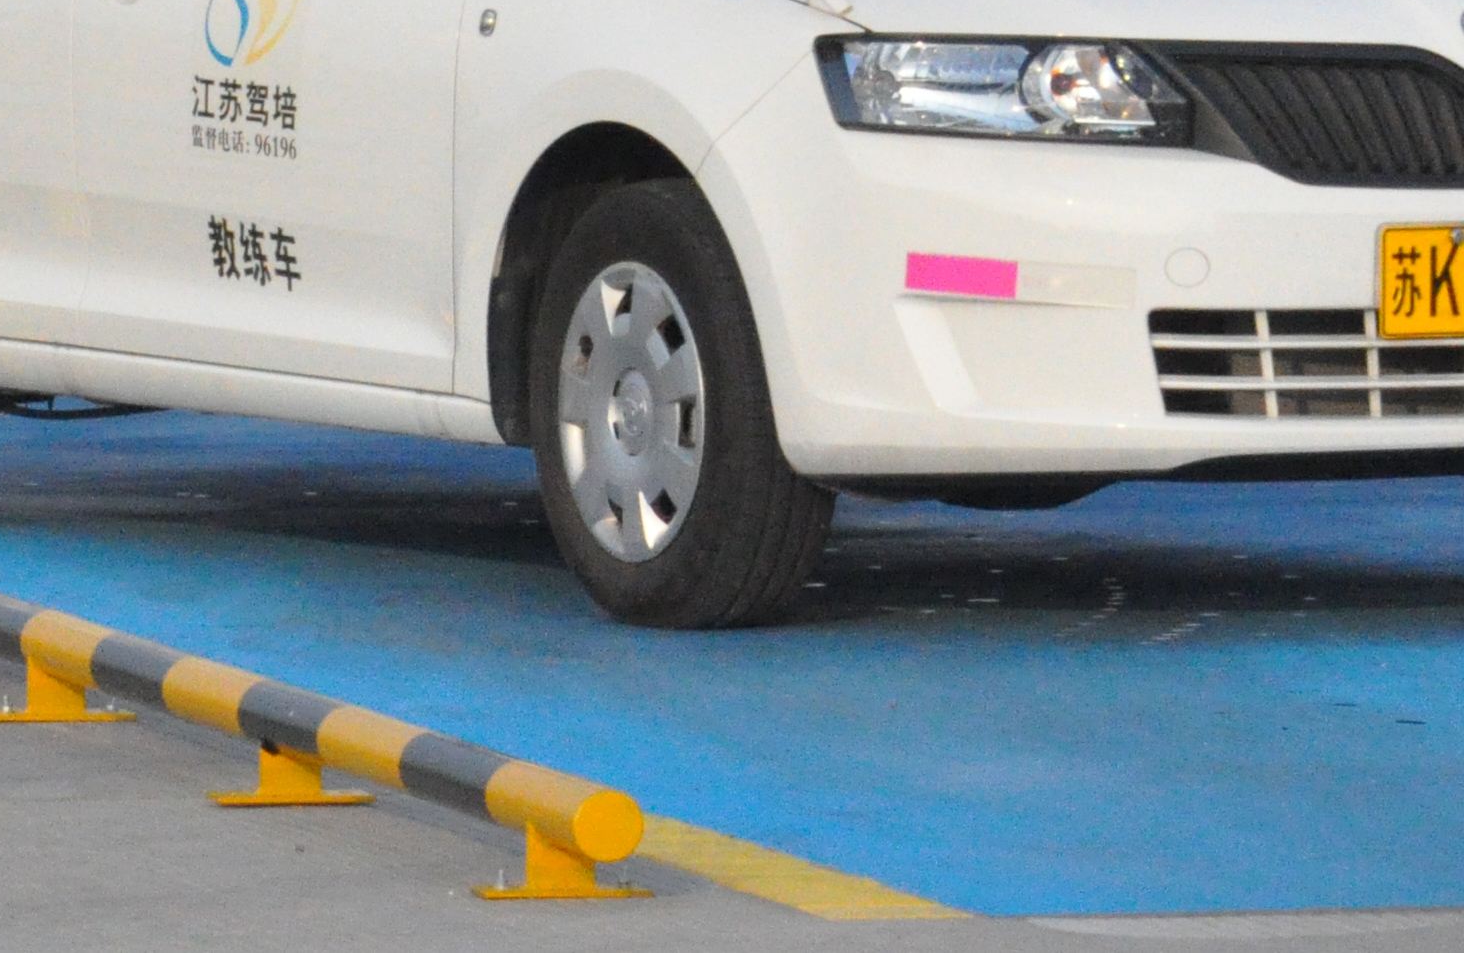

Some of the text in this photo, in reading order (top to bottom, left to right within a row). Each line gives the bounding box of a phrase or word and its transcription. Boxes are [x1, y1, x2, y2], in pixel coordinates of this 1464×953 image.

[192, 74, 297, 130] 江苏驾培
[207, 214, 302, 292] 教练车
